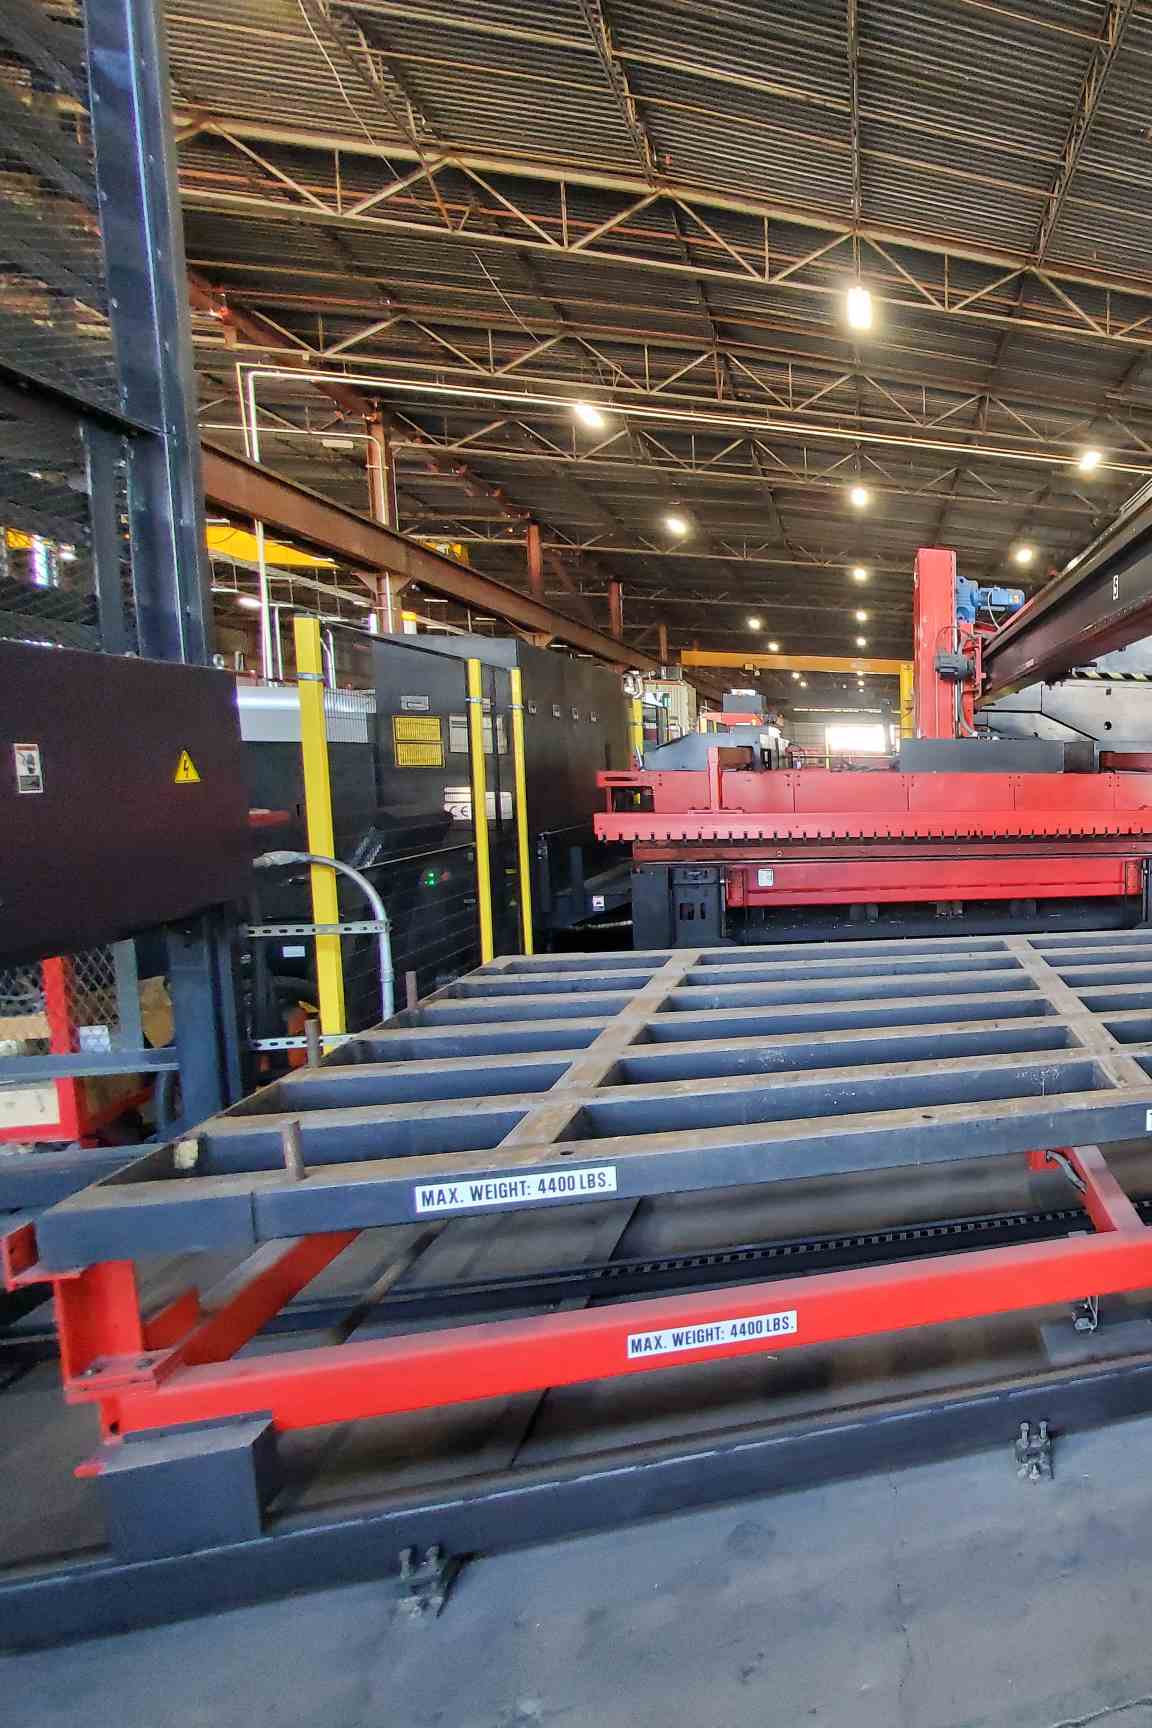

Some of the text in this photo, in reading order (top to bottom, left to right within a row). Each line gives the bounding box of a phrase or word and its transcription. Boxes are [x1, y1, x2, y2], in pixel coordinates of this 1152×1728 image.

[422, 1172, 612, 1207] MAX. WEIGHT: 4400 LBS.
[631, 1315, 795, 1354] MAX. WEIGHT: 4400 LBS.
